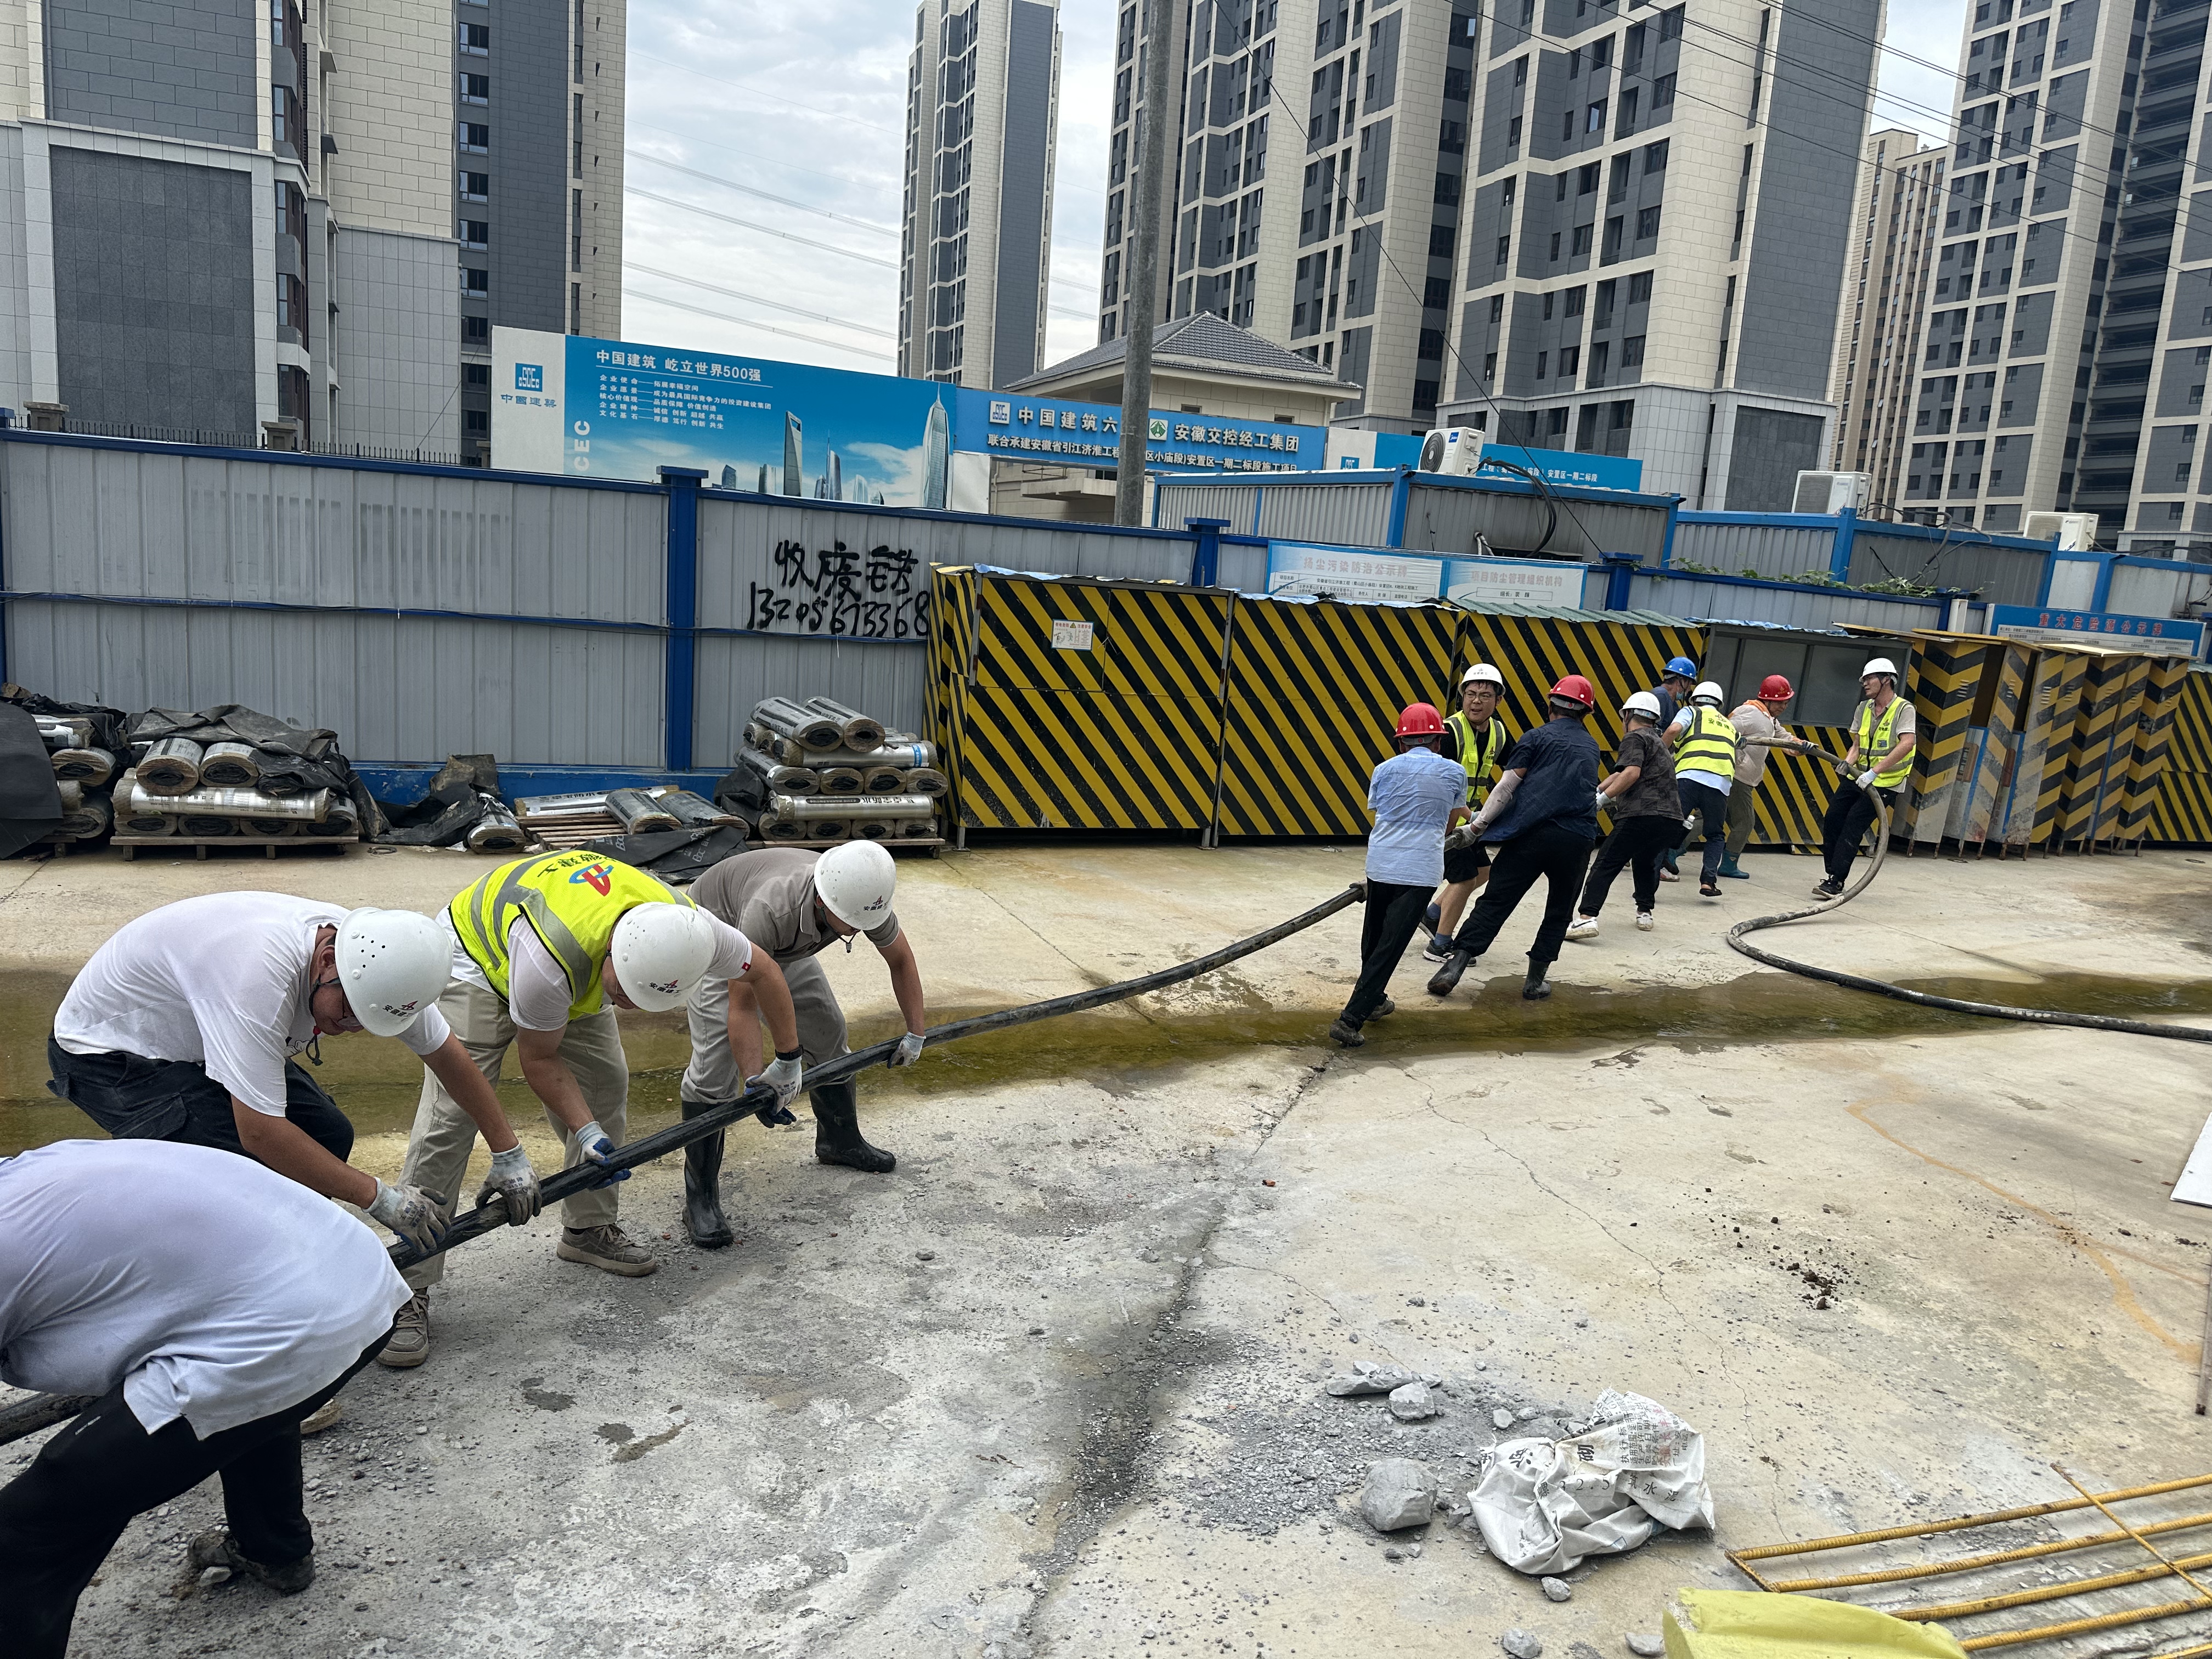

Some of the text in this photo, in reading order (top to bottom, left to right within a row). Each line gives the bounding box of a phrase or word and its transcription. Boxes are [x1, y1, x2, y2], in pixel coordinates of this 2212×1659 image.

[596, 349, 761, 382] 中国建筑 屹立世界500强
[1018, 406, 1118, 433] 中国建筑六
[1175, 424, 1299, 453] 安徽交控经工集团
[1303, 556, 1408, 578] 扬尘污染防治公示牌
[1471, 571, 1562, 587] 项目防尘管理组织机构
[2039, 613, 2163, 636] 重大危险源公示牌
